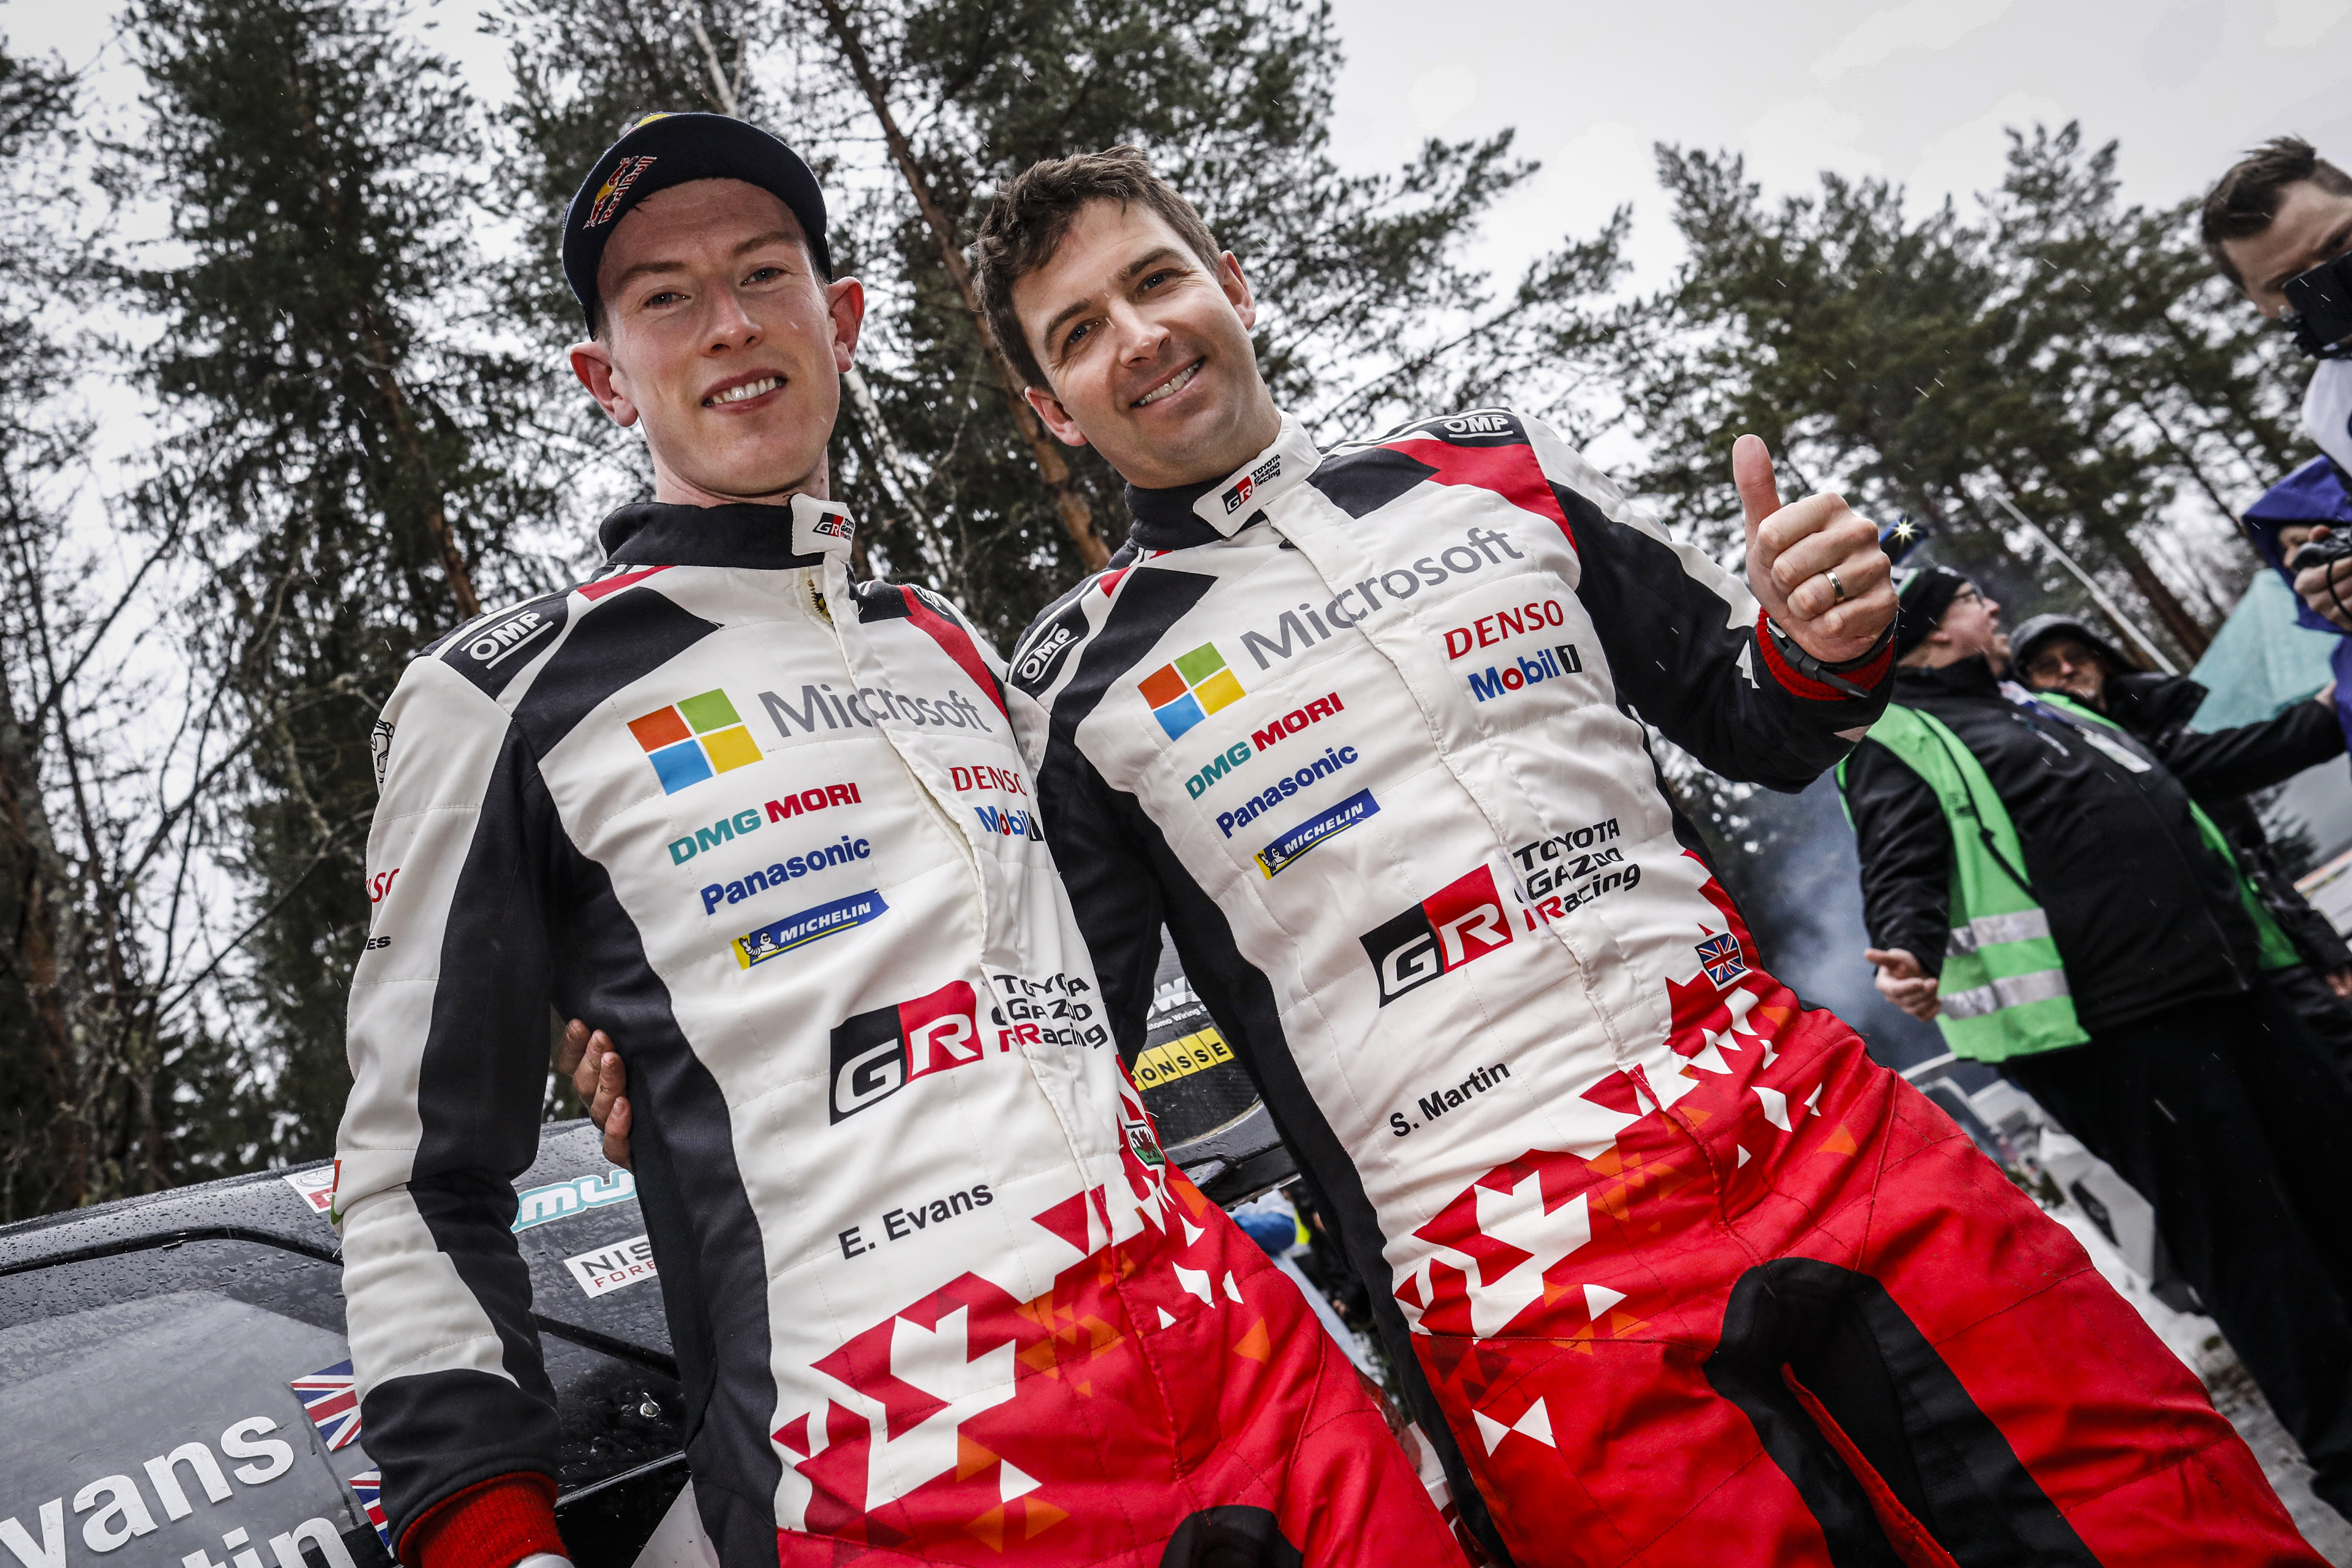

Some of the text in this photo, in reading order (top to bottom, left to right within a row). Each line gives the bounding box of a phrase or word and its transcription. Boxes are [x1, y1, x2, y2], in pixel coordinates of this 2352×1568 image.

[598, 156, 657, 224] Red Bull
[1444, 417, 1509, 432] OMP
[1250, 454, 1281, 478] TOYOTA
[1254, 462, 1280, 485] GAZOO
[1227, 485, 1252, 512] GR
[816, 522, 839, 535] GR
[1240, 528, 1525, 670] Microsoft
[470, 612, 540, 661] OMP
[1022, 627, 1070, 680] OMP
[1443, 600, 1564, 660] DENSO
[1468, 647, 1560, 702] Mobil
[758, 684, 993, 738] Microsoft
[1185, 692, 1344, 800] DMG MORI
[949, 766, 1027, 796] DENSO
[1216, 743, 1358, 838] Panasonic
[668, 782, 861, 866] DMG MORI
[974, 806, 1030, 836] Mobil
[1284, 803, 1363, 854] MICHELIN
[1513, 818, 1620, 871] TOYOTA
[700, 836, 871, 915] Panasonic
[1526, 847, 1624, 900] GAZOO
[1535, 864, 1640, 925] Racing
[779, 902, 872, 943] MICHELIN
[1382, 903, 1508, 995] GR
[993, 973, 1090, 997] TOYOA
[1013, 1022, 1108, 1050] Racing
[1132, 1042, 1228, 1083] ONSSE
[835, 1014, 978, 1114] GR
[1390, 1063, 1510, 1137] S. Martin
[839, 1185, 993, 1260] E. Evans
[580, 1242, 652, 1278] NIS
[594, 1260, 656, 1288] FORE
[0, 1417, 294, 1568] vans
